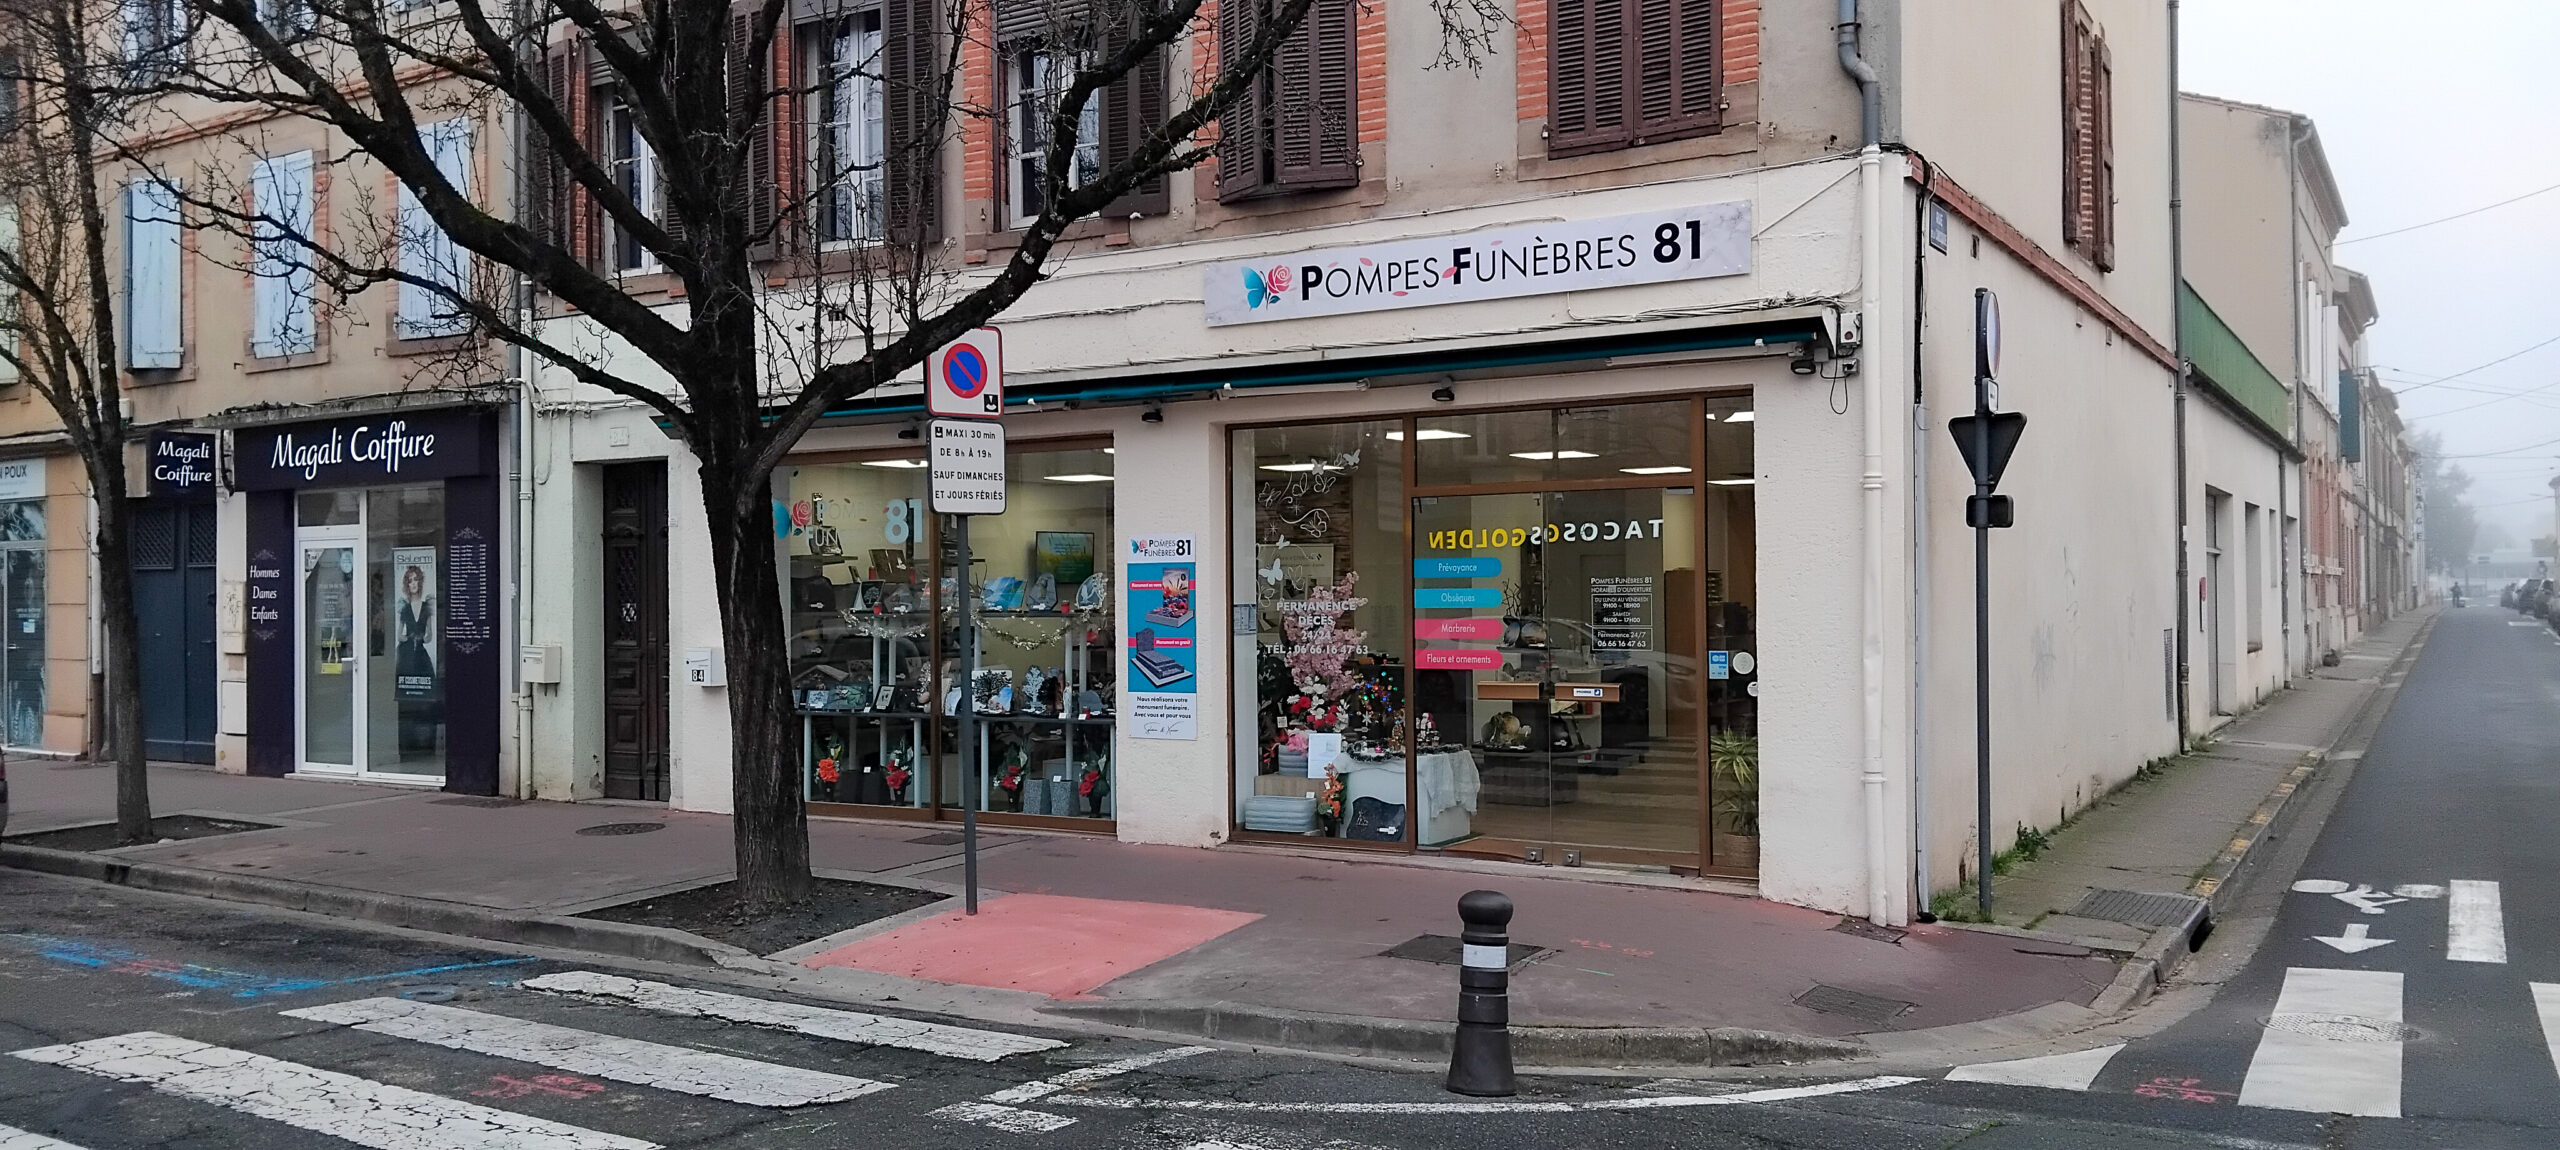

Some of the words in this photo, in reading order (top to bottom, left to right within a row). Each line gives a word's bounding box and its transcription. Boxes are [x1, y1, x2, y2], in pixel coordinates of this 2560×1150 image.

[1301, 257, 1440, 301] POMPES
[1453, 234, 1636, 285] FUNÈBRES
[1653, 220, 1701, 263] 81
[945, 428, 968, 438] MAXI
[970, 430, 982, 439] 30
[983, 431, 996, 439] min
[157, 441, 210, 464] Magali
[271, 427, 343, 480] Magali
[351, 420, 435, 473] Coiffure
[940, 447, 952, 457] DE
[968, 446, 974, 458] À
[4, 464, 27, 479] POUX
[154, 465, 212, 487] Coiffure
[933, 470, 955, 480] SAUF
[957, 471, 1004, 481] DIMANCHES
[935, 490, 945, 499] ET
[947, 490, 974, 500] JOURS
[975, 489, 1004, 500] FÉRIÉS
[884, 498, 923, 544] 81
[1149, 539, 1176, 548] POMPES
[1176, 539, 1191, 556] 81
[1144, 548, 1176, 557] FUNÈBRES
[249, 565, 280, 578] Hommes
[1438, 562, 1478, 574] Prévoyance
[252, 585, 277, 599] Dames
[1440, 592, 1475, 604] Obsèques
[1276, 601, 1357, 611] PERMANENCE
[251, 605, 278, 625] Enfants
[1298, 614, 1333, 626] DÉCÈS
[1441, 624, 1476, 633] Marbrerie
[1301, 630, 1331, 641] 24/24
[1630, 631, 1646, 639] 24/7
[1265, 642, 1287, 654] TÉL
[1294, 645, 1307, 654] 06
[1309, 645, 1322, 654] 66
[1326, 645, 1338, 654] 16
[1340, 645, 1355, 654] 47
[1355, 645, 1369, 655] 63
[1426, 653, 1447, 663] Fleurs
[1448, 655, 1455, 663] et
[1455, 655, 1491, 664] ornements
[692, 670, 704, 681] 84
